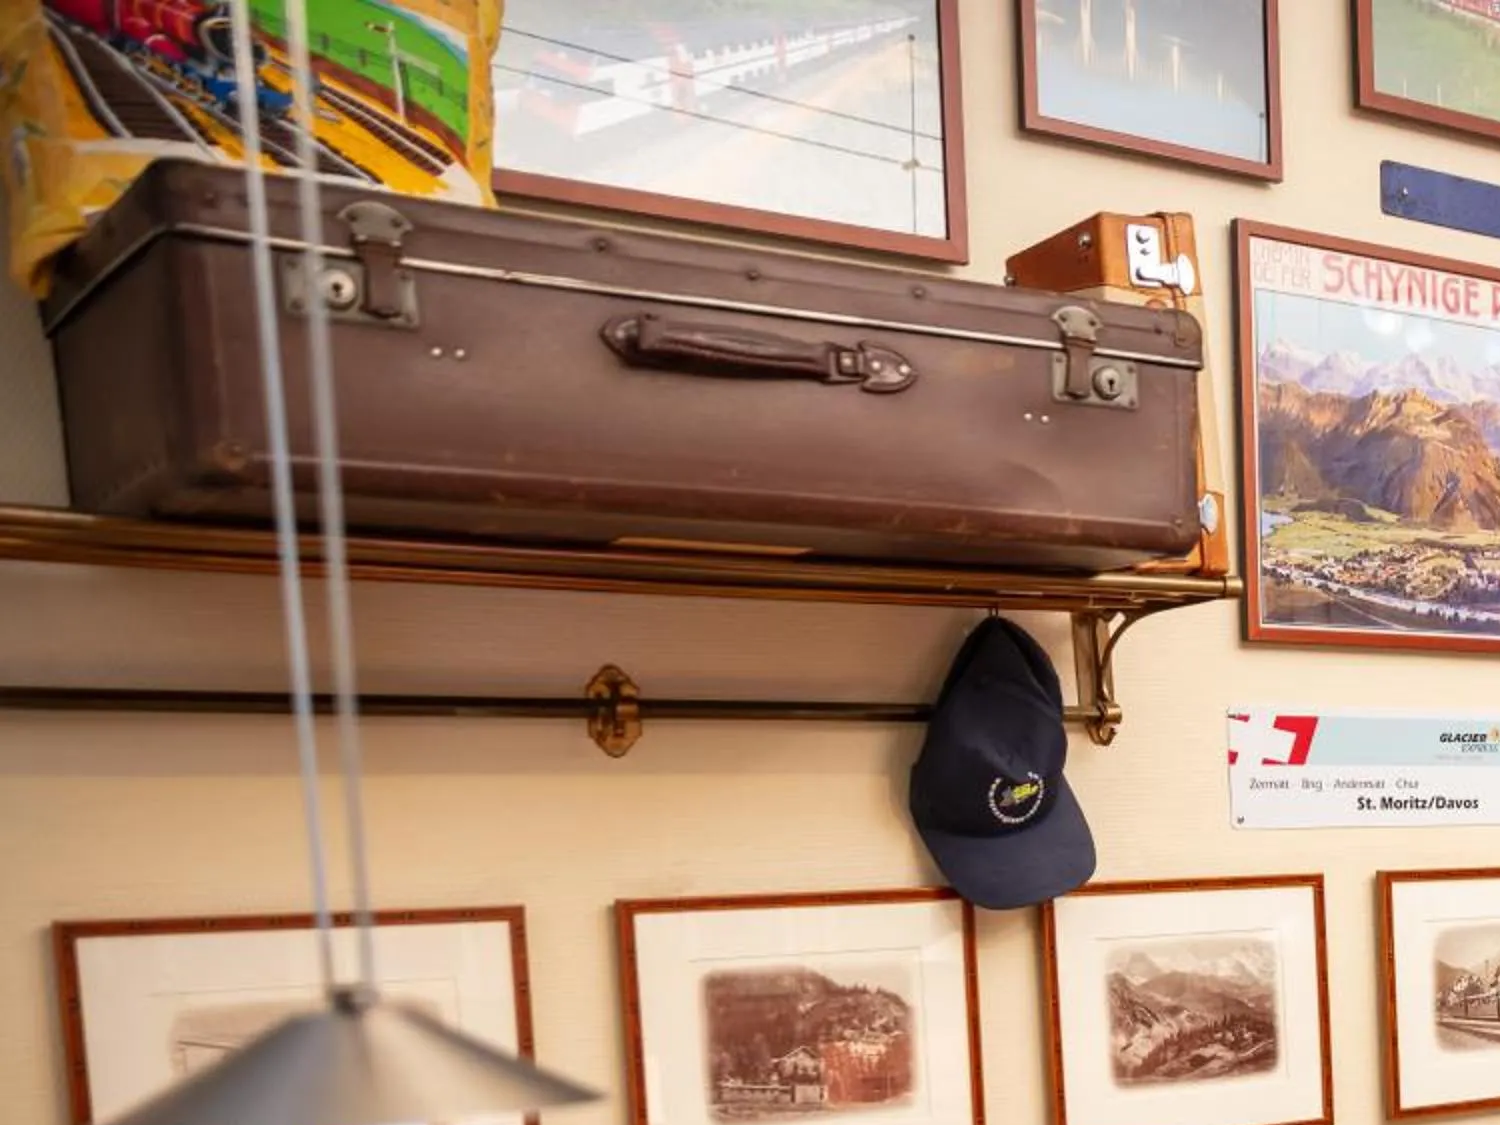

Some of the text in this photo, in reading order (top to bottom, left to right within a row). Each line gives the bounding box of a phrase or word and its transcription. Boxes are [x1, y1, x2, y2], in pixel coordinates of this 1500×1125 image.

[1321, 253, 1480, 317] SCHYNIGE
[1439, 732, 1488, 743] GLACIER
[1357, 795, 1479, 811] St. Moritz/Davos
